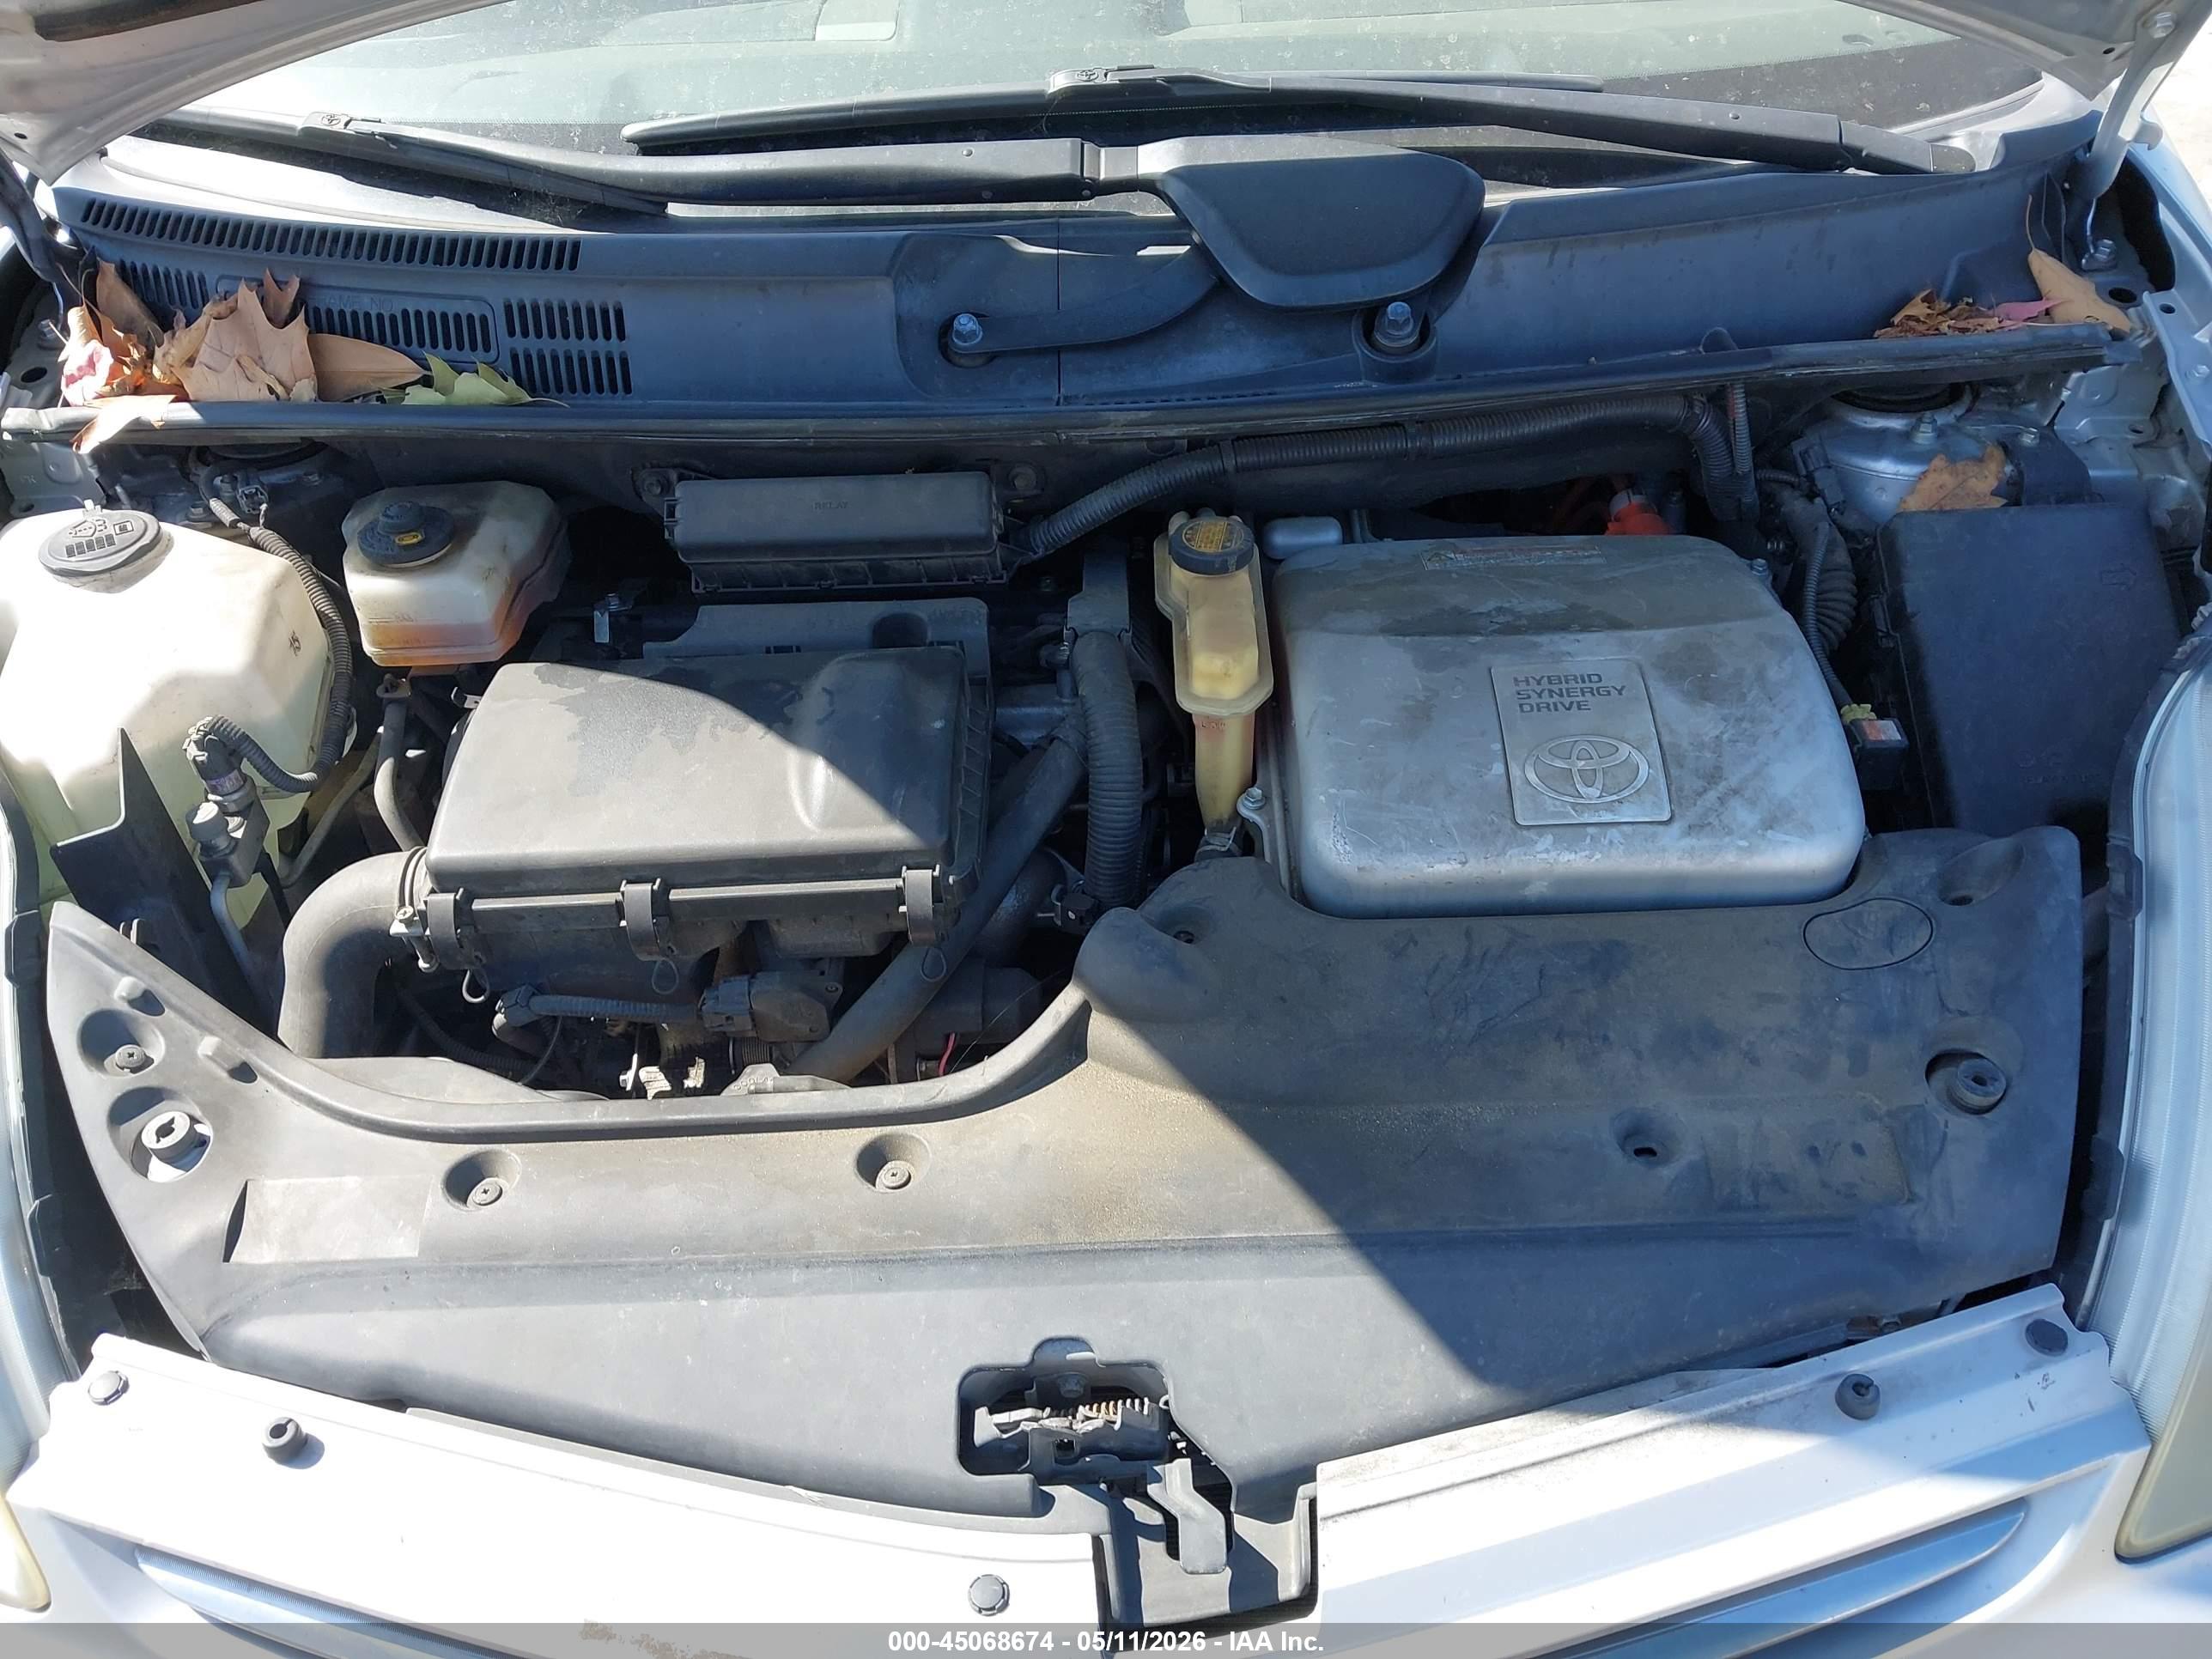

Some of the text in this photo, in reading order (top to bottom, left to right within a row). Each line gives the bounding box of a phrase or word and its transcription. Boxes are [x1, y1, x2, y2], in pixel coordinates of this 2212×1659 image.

[1513, 673, 1602, 687] HYBRID
[1516, 685, 1626, 701] SYNERGY
[1518, 700, 1591, 714] DRIVE
